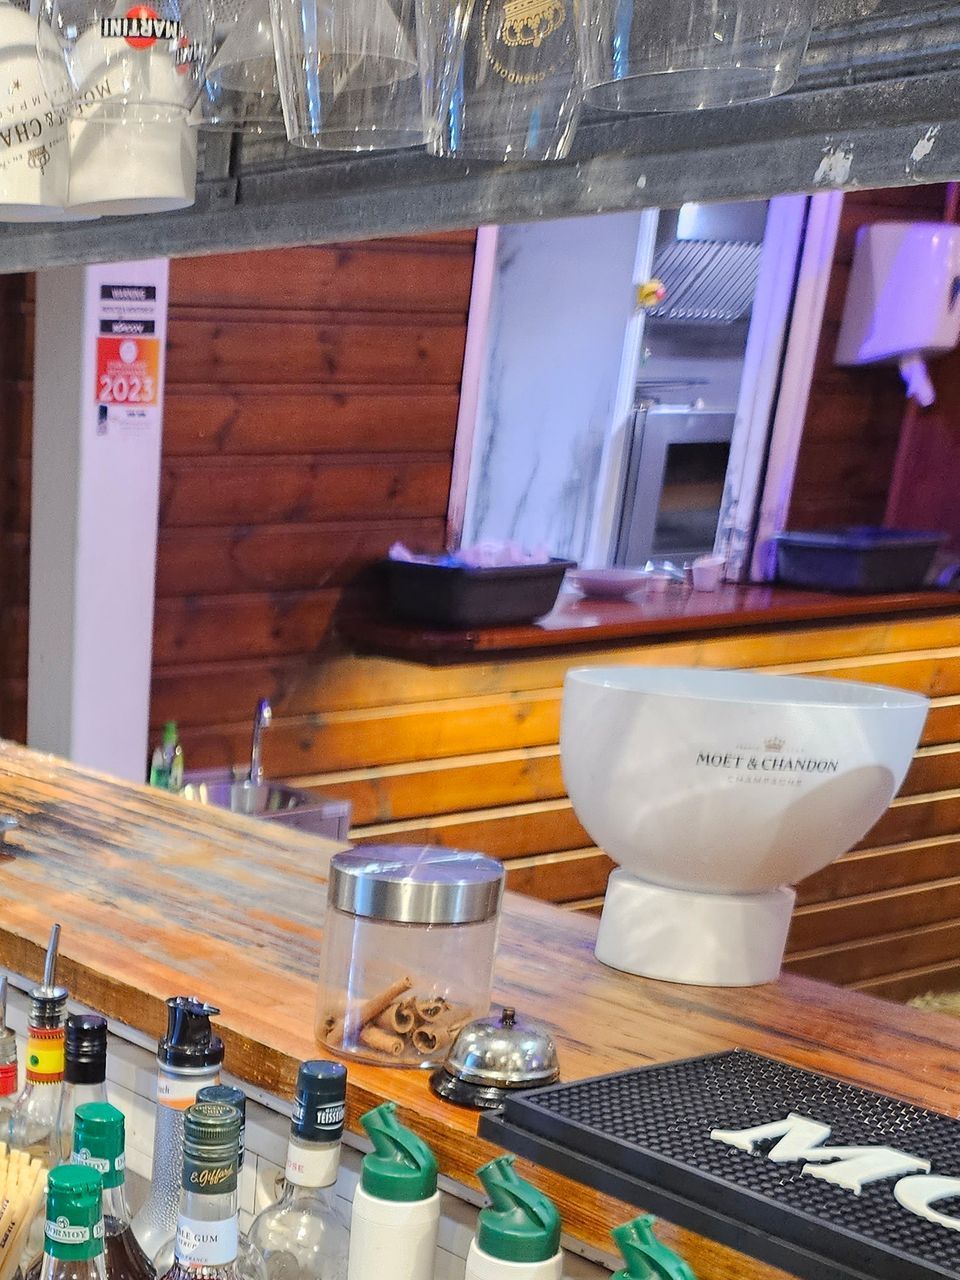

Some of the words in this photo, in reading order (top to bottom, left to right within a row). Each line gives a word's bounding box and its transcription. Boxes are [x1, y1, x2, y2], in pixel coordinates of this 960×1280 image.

[102, 18, 181, 39] MARTINI
[100, 374, 154, 402] 2023
[696, 752, 744, 769] MOËT
[747, 758, 759, 771] &
[761, 757, 839, 773] CHANDON
[199, 1163, 235, 1187] Giffard
[45, 1223, 88, 1239] DORMOY
[193, 1233, 218, 1244] GUM
